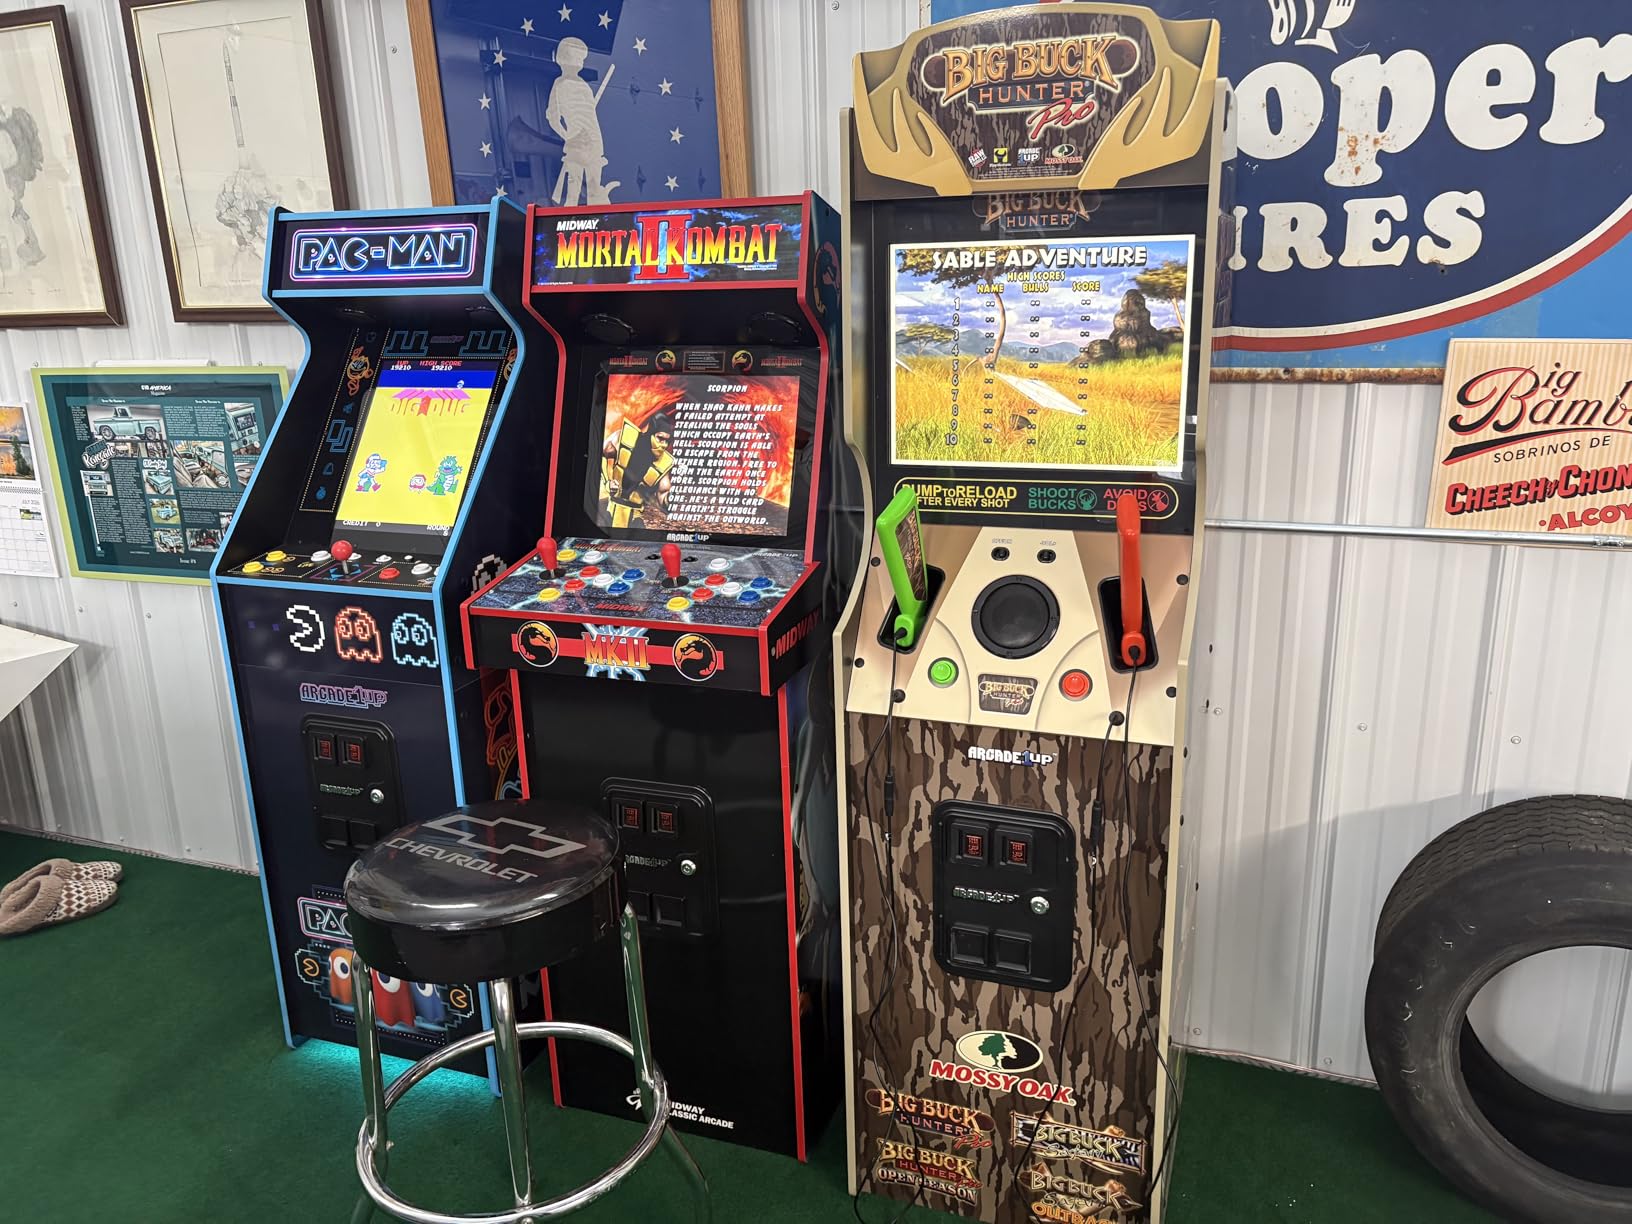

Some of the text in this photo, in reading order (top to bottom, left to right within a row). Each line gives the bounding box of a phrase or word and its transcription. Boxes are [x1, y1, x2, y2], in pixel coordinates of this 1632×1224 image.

[942, 36, 1118, 104] BIG BUCK
[979, 81, 1084, 105] HUNTER
[1222, 33, 1632, 187] oper
[1027, 97, 1095, 139] Pro
[556, 219, 599, 231] MIDWAY
[1006, 214, 1070, 227] HUNTER
[1228, 190, 1486, 272] IRES
[299, 233, 465, 271] PAC-MAN
[555, 224, 782, 268] MORTAL KOMBAT
[932, 246, 1148, 269] SABLE ADVENTURE
[1007, 270, 1065, 282] HIGH SCORES
[976, 281, 1100, 294] NAME BULLS SCORE
[953, 297, 960, 310] 1
[952, 314, 960, 326] 2
[952, 329, 959, 341] 3
[952, 344, 959, 356] 4
[952, 359, 959, 371] 5
[952, 374, 959, 386] 6
[951, 389, 959, 401] 7
[952, 404, 959, 415] 8
[951, 418, 958, 430] 9
[945, 433, 958, 445] 10
[1494, 435, 1611, 463] SOBRINOS DE
[942, 488, 955, 497] TO
[956, 485, 1017, 499] RELOAD
[1028, 487, 1077, 499] SHOOT
[1445, 477, 1548, 515] CHEECH
[916, 497, 1010, 508] FTER EVERY SHOT
[1028, 499, 1077, 510] BUCKS
[1107, 500, 1147, 511] DS
[666, 533, 709, 543] ARCADE1UP
[595, 603, 646, 611] MIDWAY
[300, 683, 387, 708] ARCADE1UP
[968, 746, 1053, 767] ARCADE1UP
[385, 838, 538, 883] CHEVROLET
[930, 1060, 1073, 1104] MOSSY OAK
[671, 1101, 705, 1114] IDWAY
[880, 1089, 984, 1138] BIG BUCK
[669, 1110, 734, 1129] ASSIC ARCADE
[953, 1134, 992, 1150] Pro
[1035, 1127, 1122, 1160] BIG BUCK
[878, 1138, 976, 1180] BIG BUCK
[878, 1168, 916, 1184] OPEN
[1031, 1171, 1121, 1210] BIG BUCK
[1031, 1202, 1110, 1224] OUTBA
